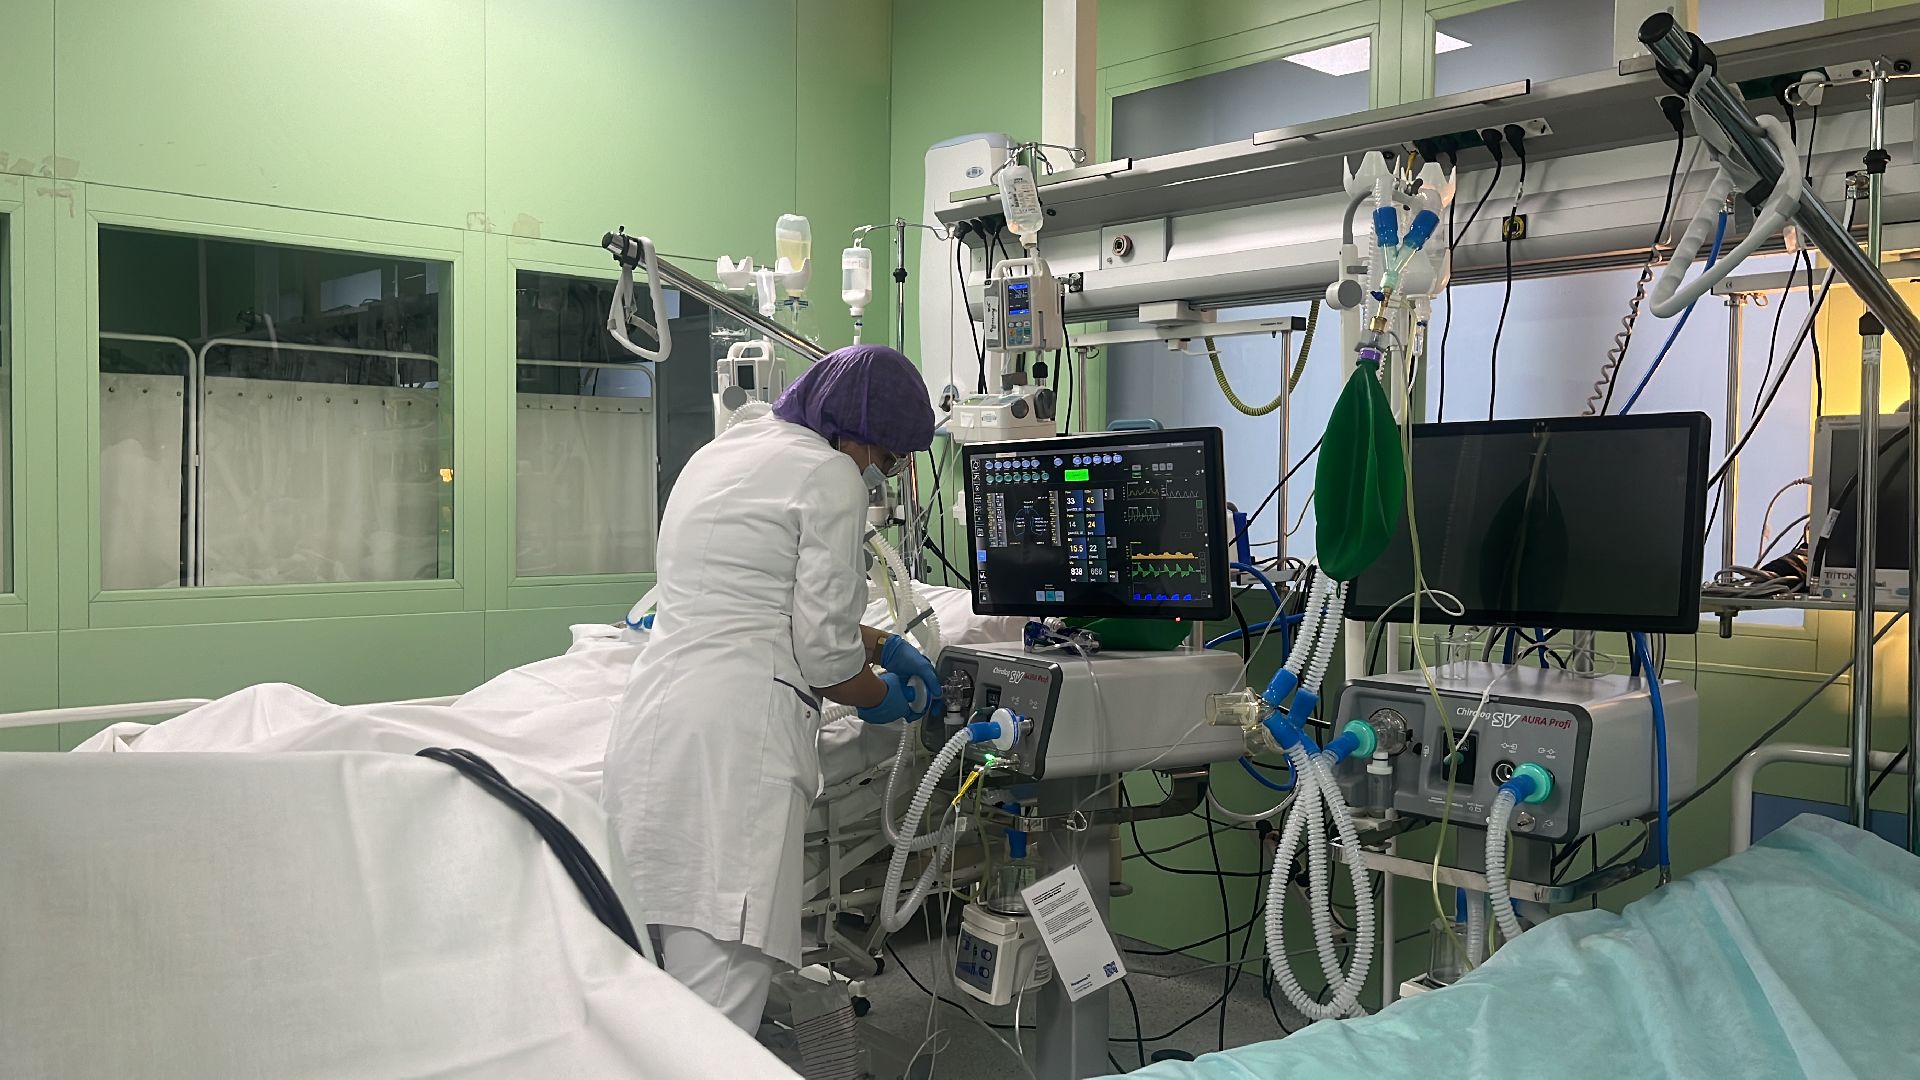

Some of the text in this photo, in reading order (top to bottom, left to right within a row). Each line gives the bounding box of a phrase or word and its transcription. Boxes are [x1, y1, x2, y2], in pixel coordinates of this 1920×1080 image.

[1066, 497, 1076, 505] 33
[1086, 496, 1095, 504] 45
[1089, 544, 1098, 552] 22
[1491, 712, 1521, 728] SV
[1521, 715, 1547, 726] AURA
[1549, 718, 1571, 729] Profi
